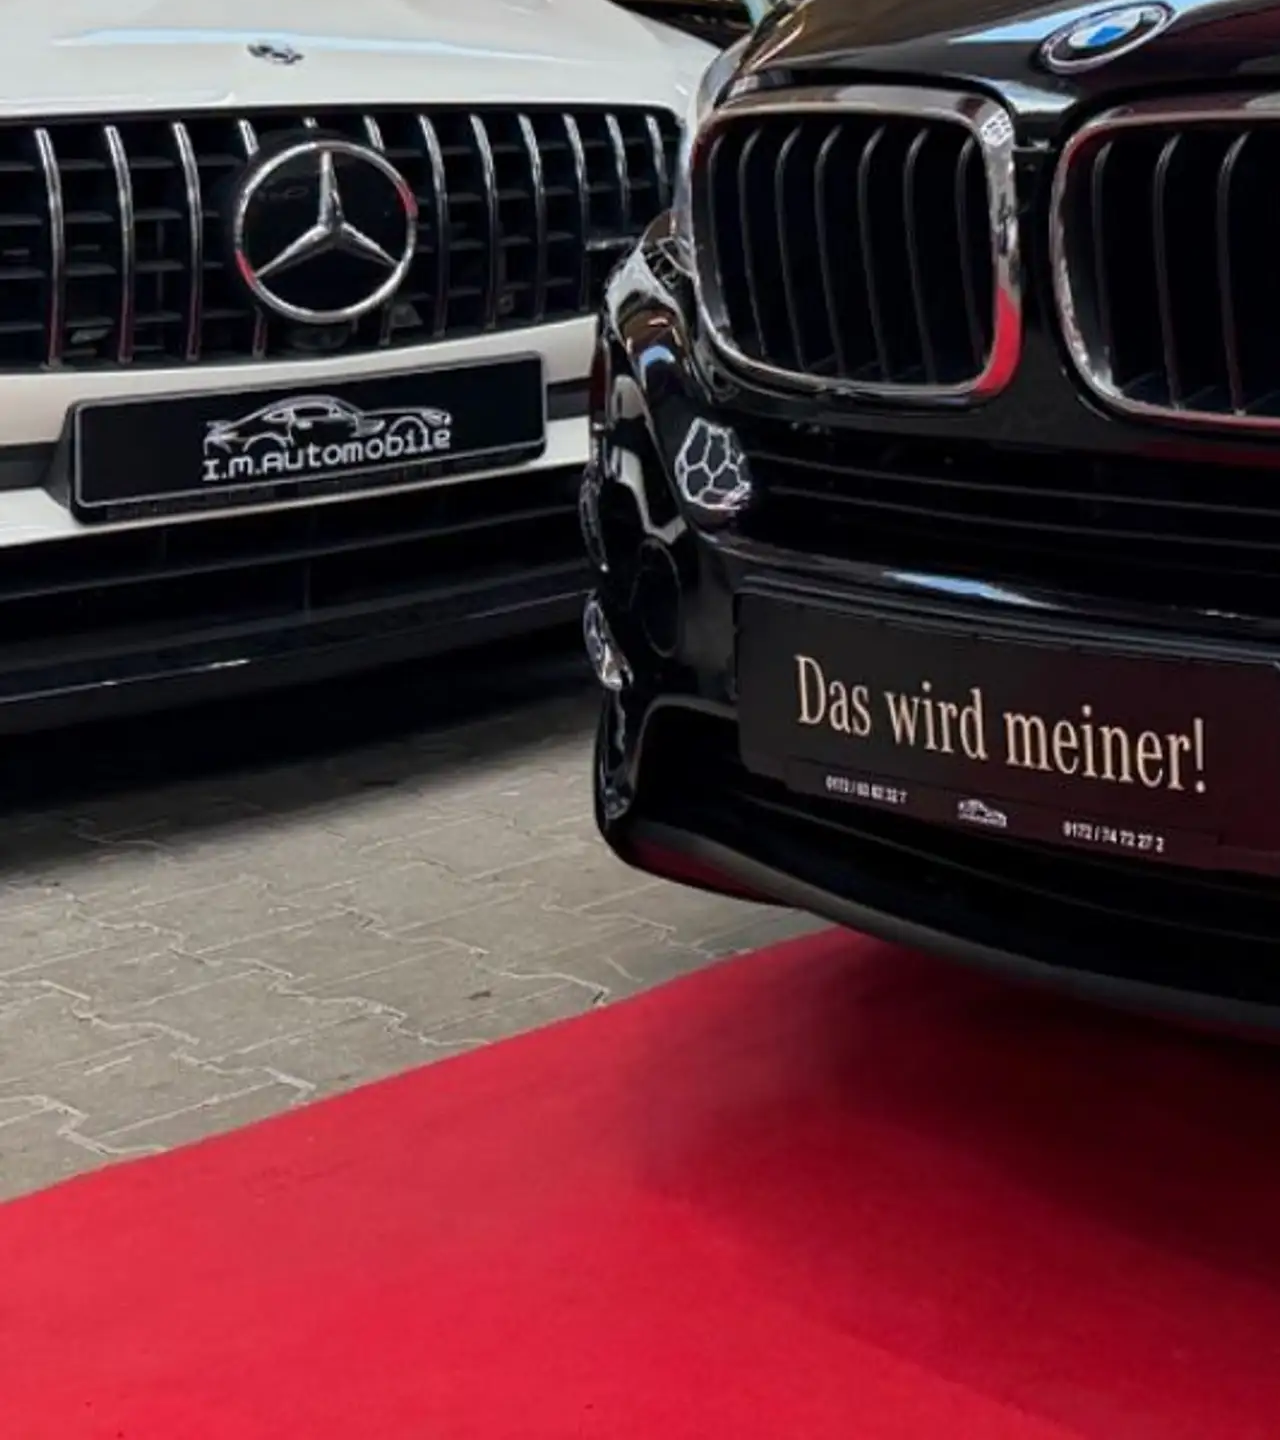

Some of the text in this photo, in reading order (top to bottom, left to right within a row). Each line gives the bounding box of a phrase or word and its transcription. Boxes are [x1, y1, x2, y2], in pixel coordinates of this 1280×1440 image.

[794, 653, 1206, 795] Das wird meiner!
